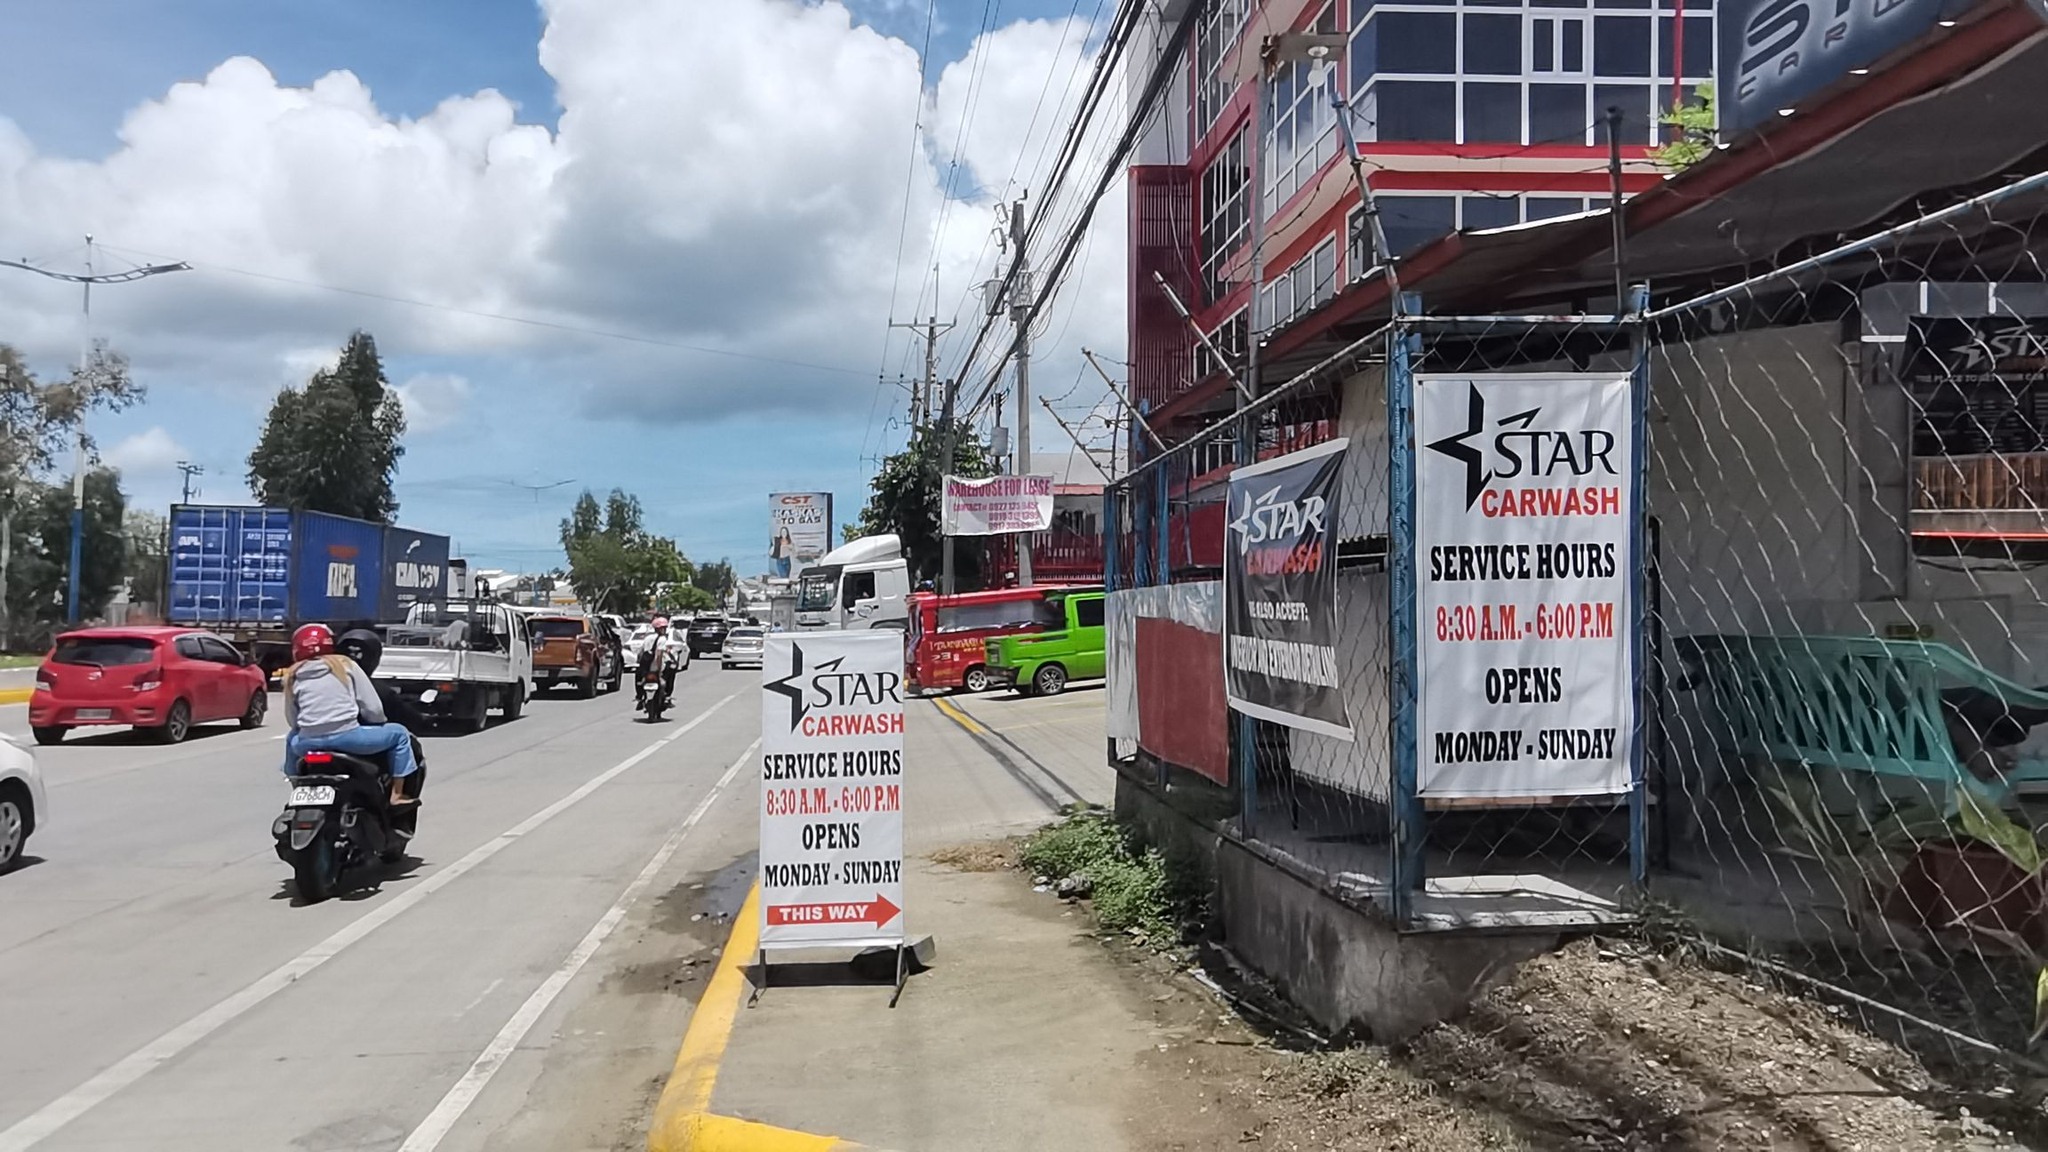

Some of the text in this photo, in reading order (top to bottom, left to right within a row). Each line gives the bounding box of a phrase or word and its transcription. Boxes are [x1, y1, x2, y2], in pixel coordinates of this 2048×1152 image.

[1494, 430, 1619, 478] STAR
[781, 496, 812, 504] CST
[1005, 479, 1021, 496] FOR
[1024, 479, 1050, 496] LEASE
[1481, 487, 1619, 518] CARWASH
[799, 516, 821, 524] GAS
[1252, 496, 1325, 543] STAR
[1431, 543, 1616, 582] SERVICE HOURS
[1257, 601, 1274, 619] ALSO
[1276, 602, 1309, 621] ACCEPT:
[1437, 605, 1476, 641] 8:30
[1537, 603, 1576, 639] 6:00
[1580, 603, 1613, 638] P.M
[812, 672, 903, 708] STAR
[1485, 667, 1562, 704] OPENS
[802, 713, 904, 737] CARWASH
[1435, 730, 1523, 764] MONDAY
[1538, 728, 1617, 760] SUNDAY
[764, 750, 901, 780] SERVICE HOURS
[767, 788, 796, 816] 8:30
[842, 786, 871, 812] 6:00
[874, 785, 900, 812] P.M
[802, 823, 860, 850] OPENS
[765, 862, 831, 888] MONDAY
[843, 860, 901, 884] SUNDAY
[779, 905, 869, 921] THIS WAY
